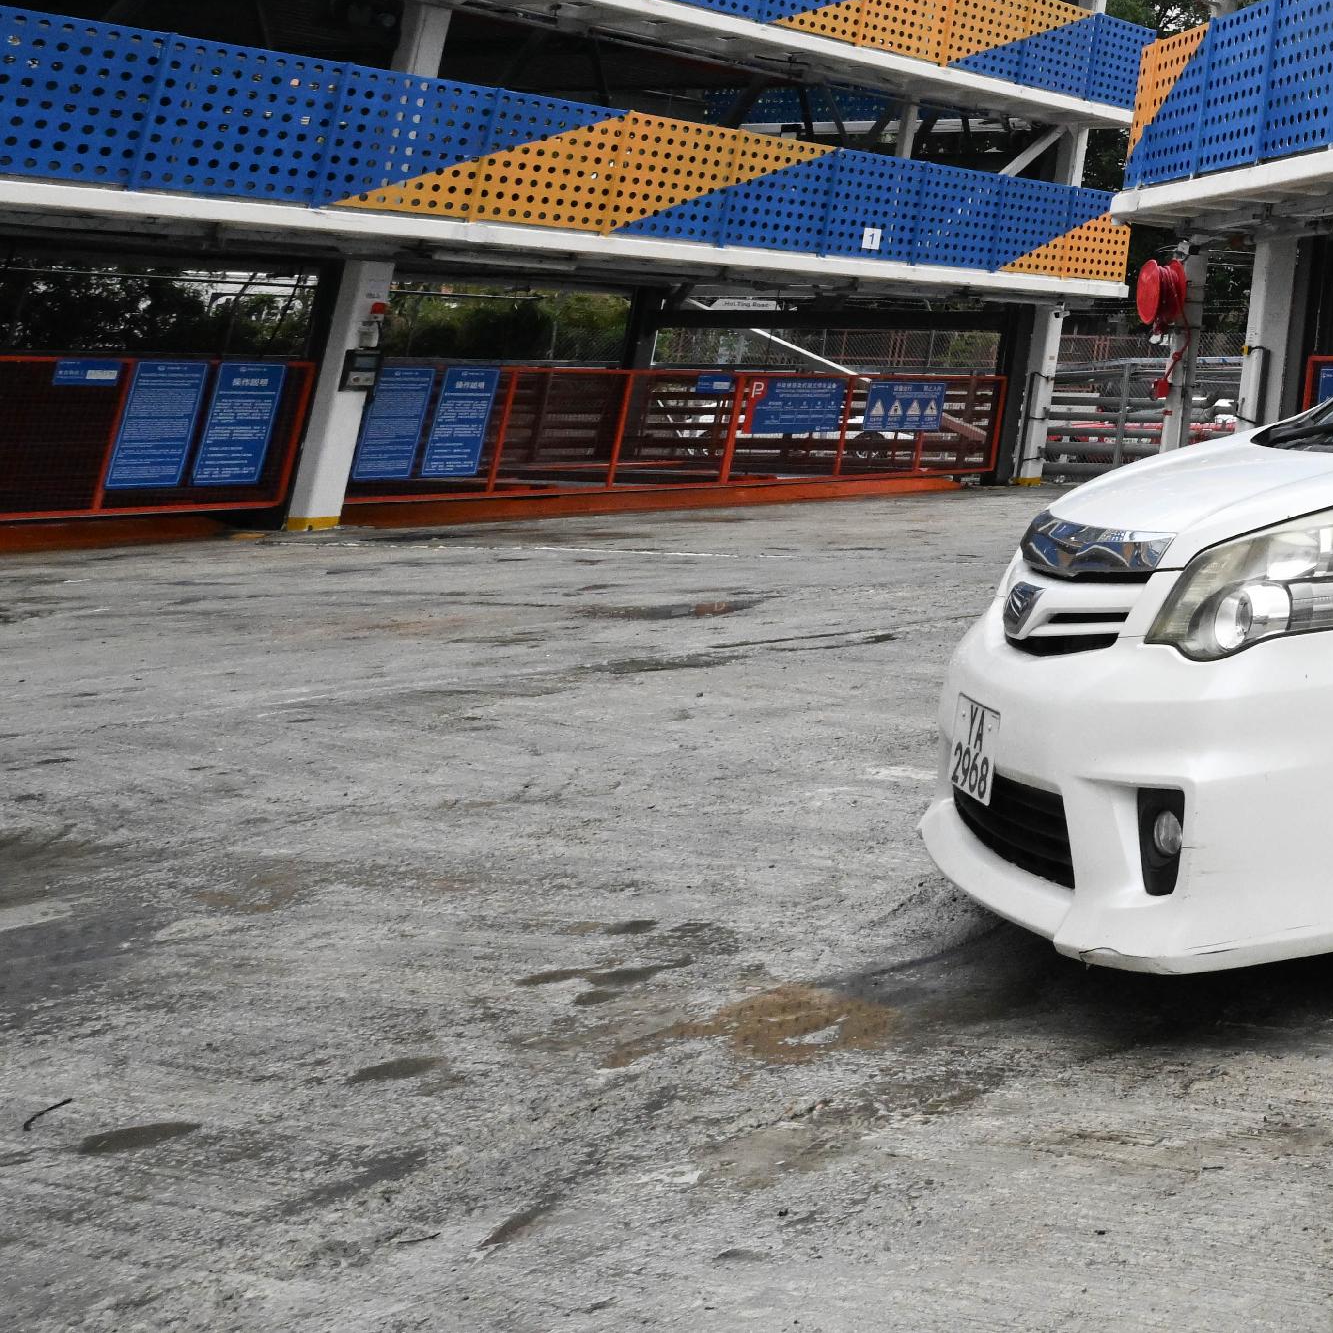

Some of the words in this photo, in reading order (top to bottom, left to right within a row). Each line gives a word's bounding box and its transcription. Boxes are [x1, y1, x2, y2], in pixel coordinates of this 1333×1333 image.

[869, 233, 875, 245] 1
[967, 704, 985, 753] YA
[951, 741, 989, 800] 2968
